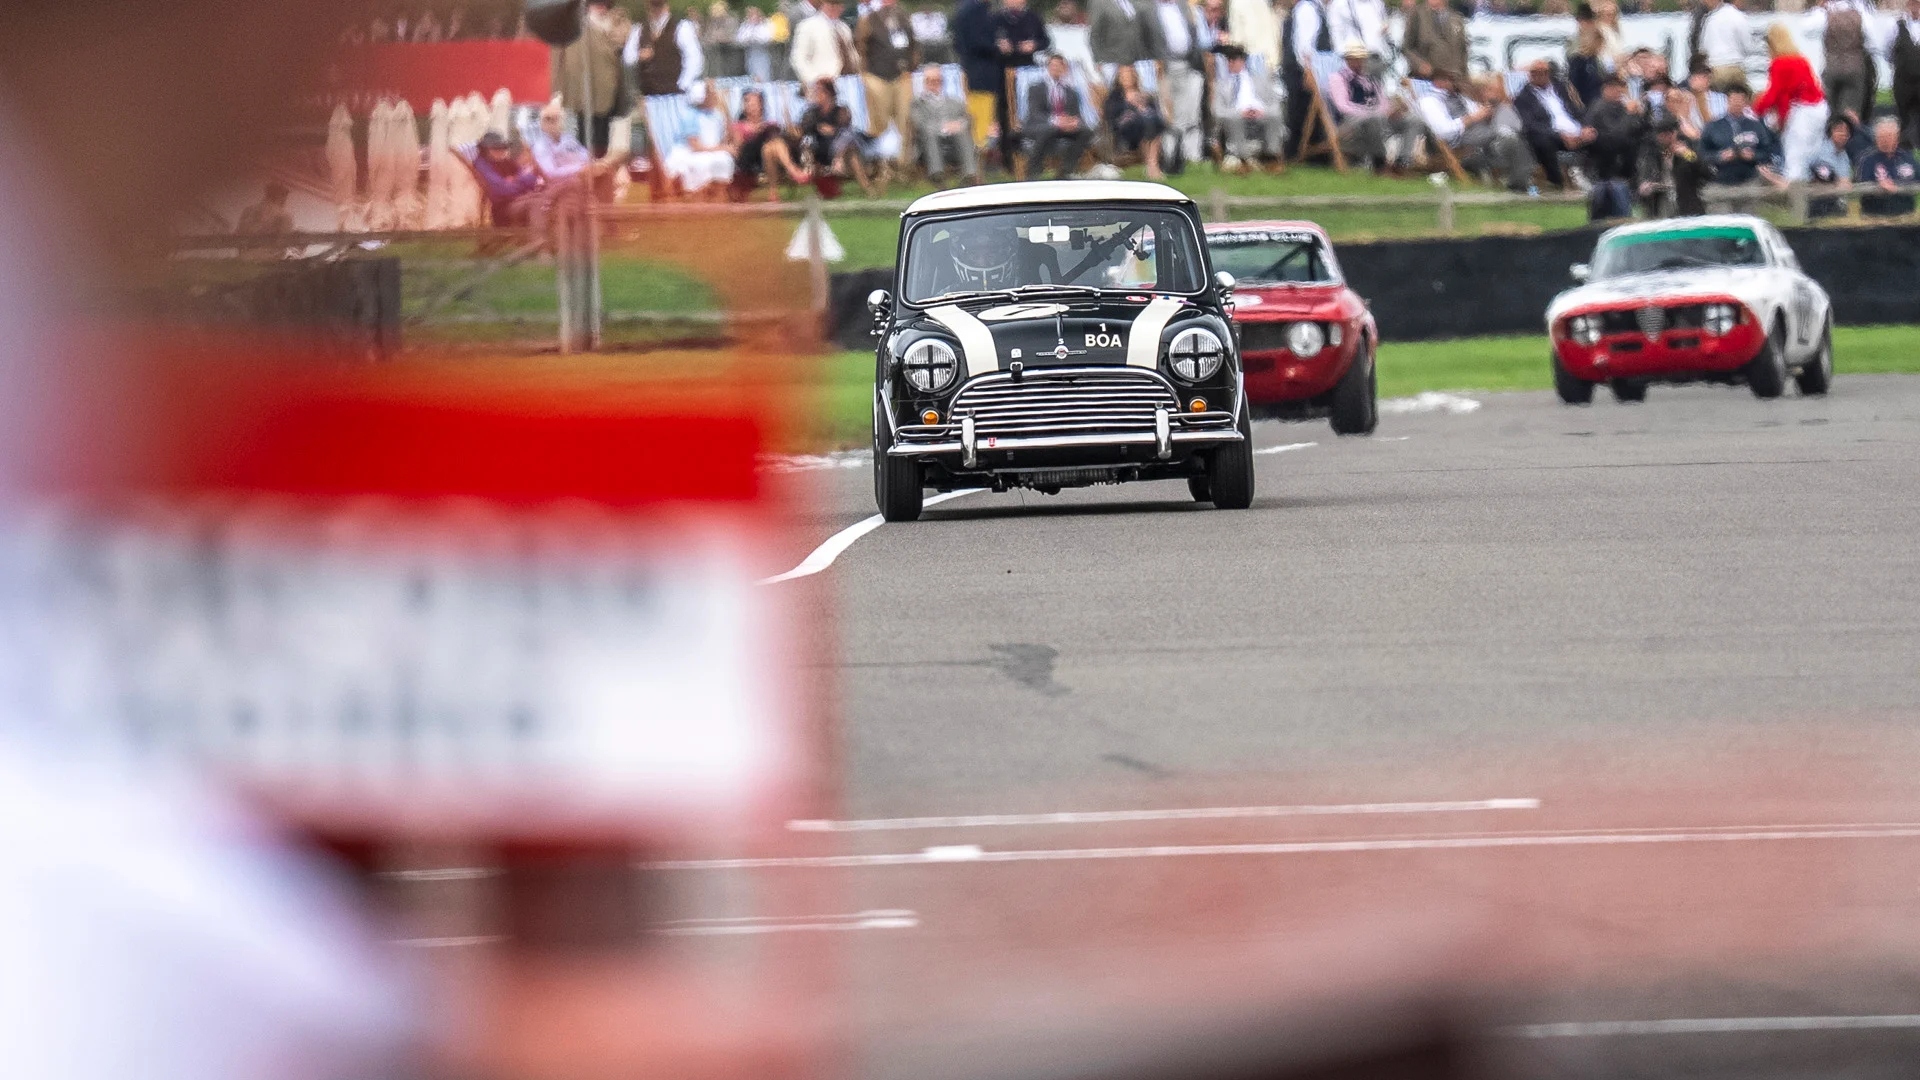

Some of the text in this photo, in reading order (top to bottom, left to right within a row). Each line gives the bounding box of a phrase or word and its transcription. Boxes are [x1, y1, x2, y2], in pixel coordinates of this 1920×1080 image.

[1004, 306, 1050, 316] 7
[1099, 322, 1106, 332] 1
[1085, 333, 1122, 347] BOA
